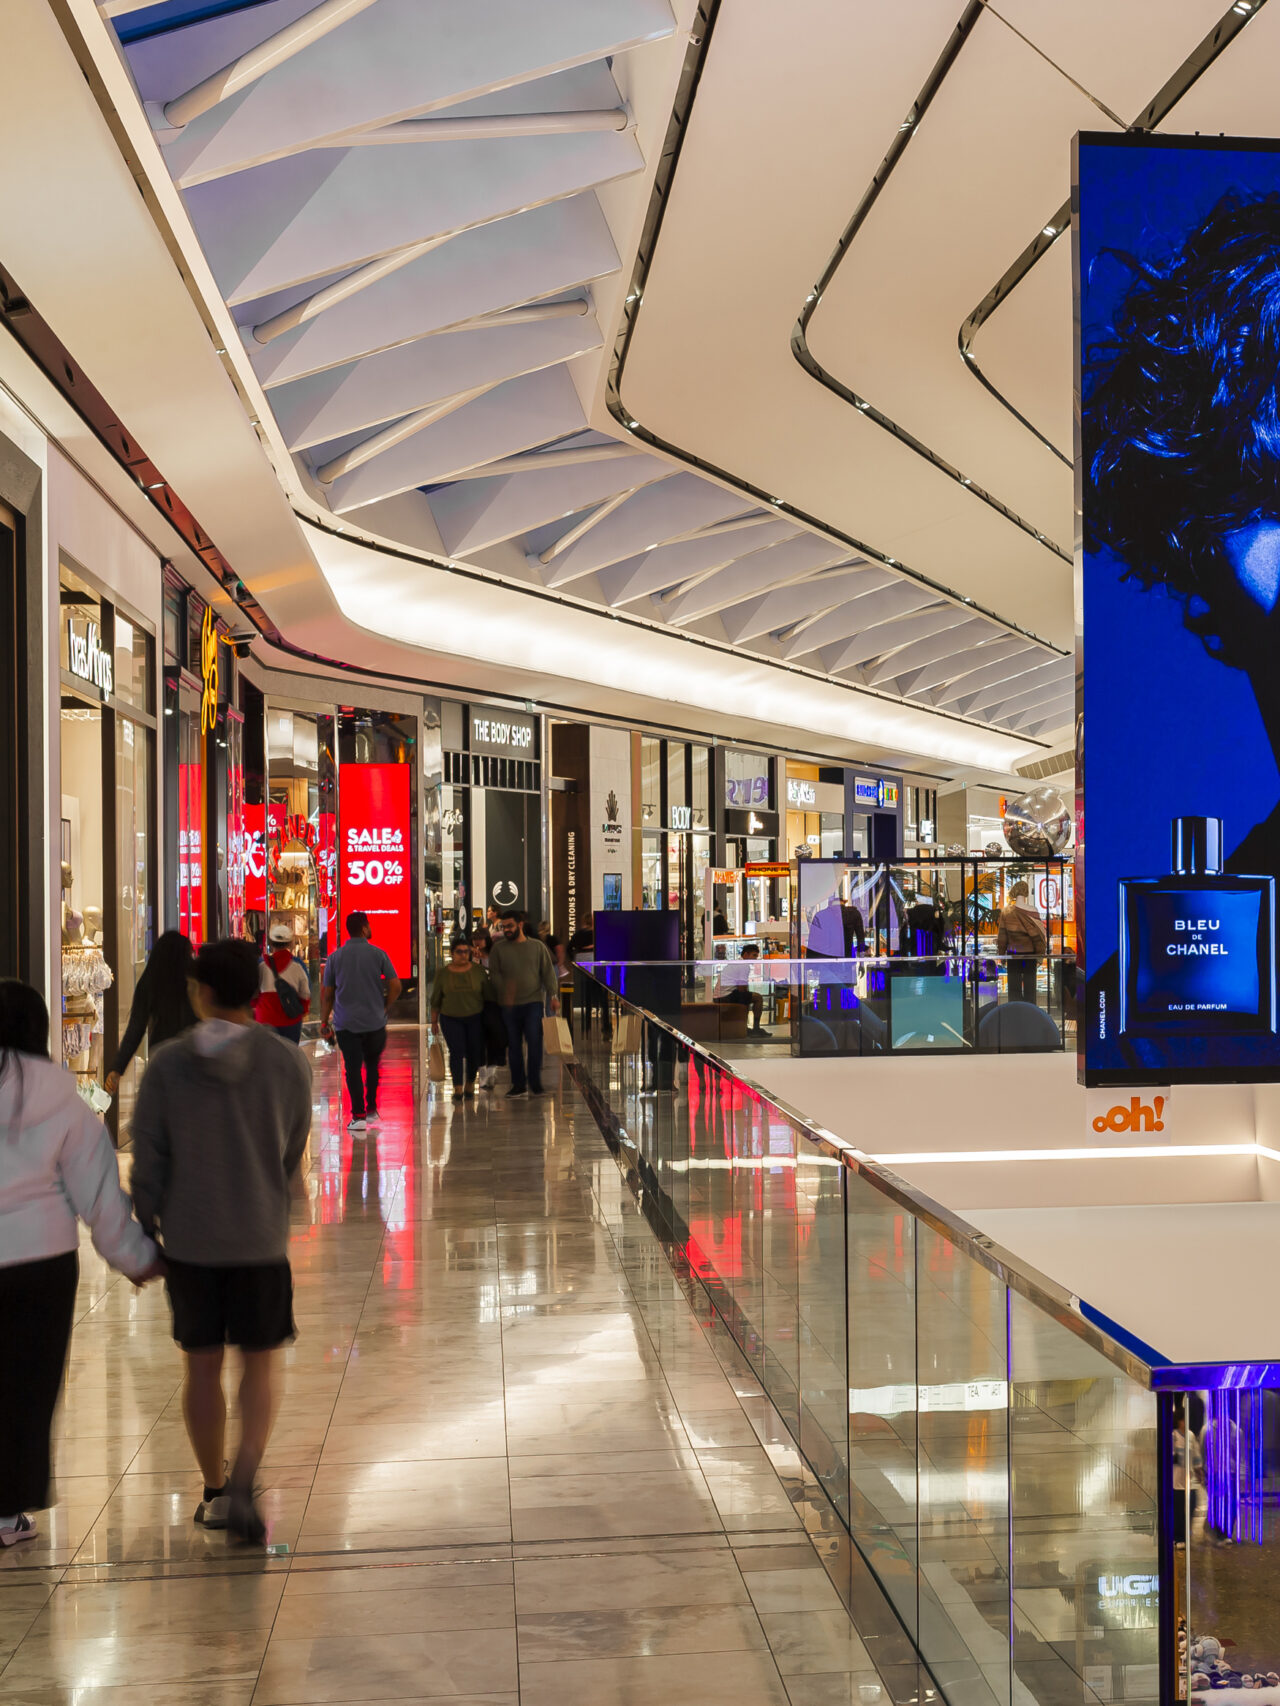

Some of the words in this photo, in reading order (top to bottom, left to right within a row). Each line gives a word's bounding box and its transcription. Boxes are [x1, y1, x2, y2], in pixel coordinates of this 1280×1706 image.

[474, 718, 490, 742] THE
[490, 722, 511, 745] BODY
[511, 726, 532, 748] SHOP
[671, 806, 692, 829] BODY
[347, 828, 392, 845] SALE
[354, 845, 380, 853] TRAVEL
[381, 844, 404, 852] DEALS
[567, 831, 575, 870] CLEANING
[383, 875, 403, 885] OFF
[568, 870, 576, 887] DRY
[568, 896, 577, 940] ERATIONS
[1174, 919, 1221, 931] BLEU
[1166, 943, 1229, 956] CHANEL
[1168, 1003, 1184, 1011] EAU
[1185, 1003, 1195, 1011] DE
